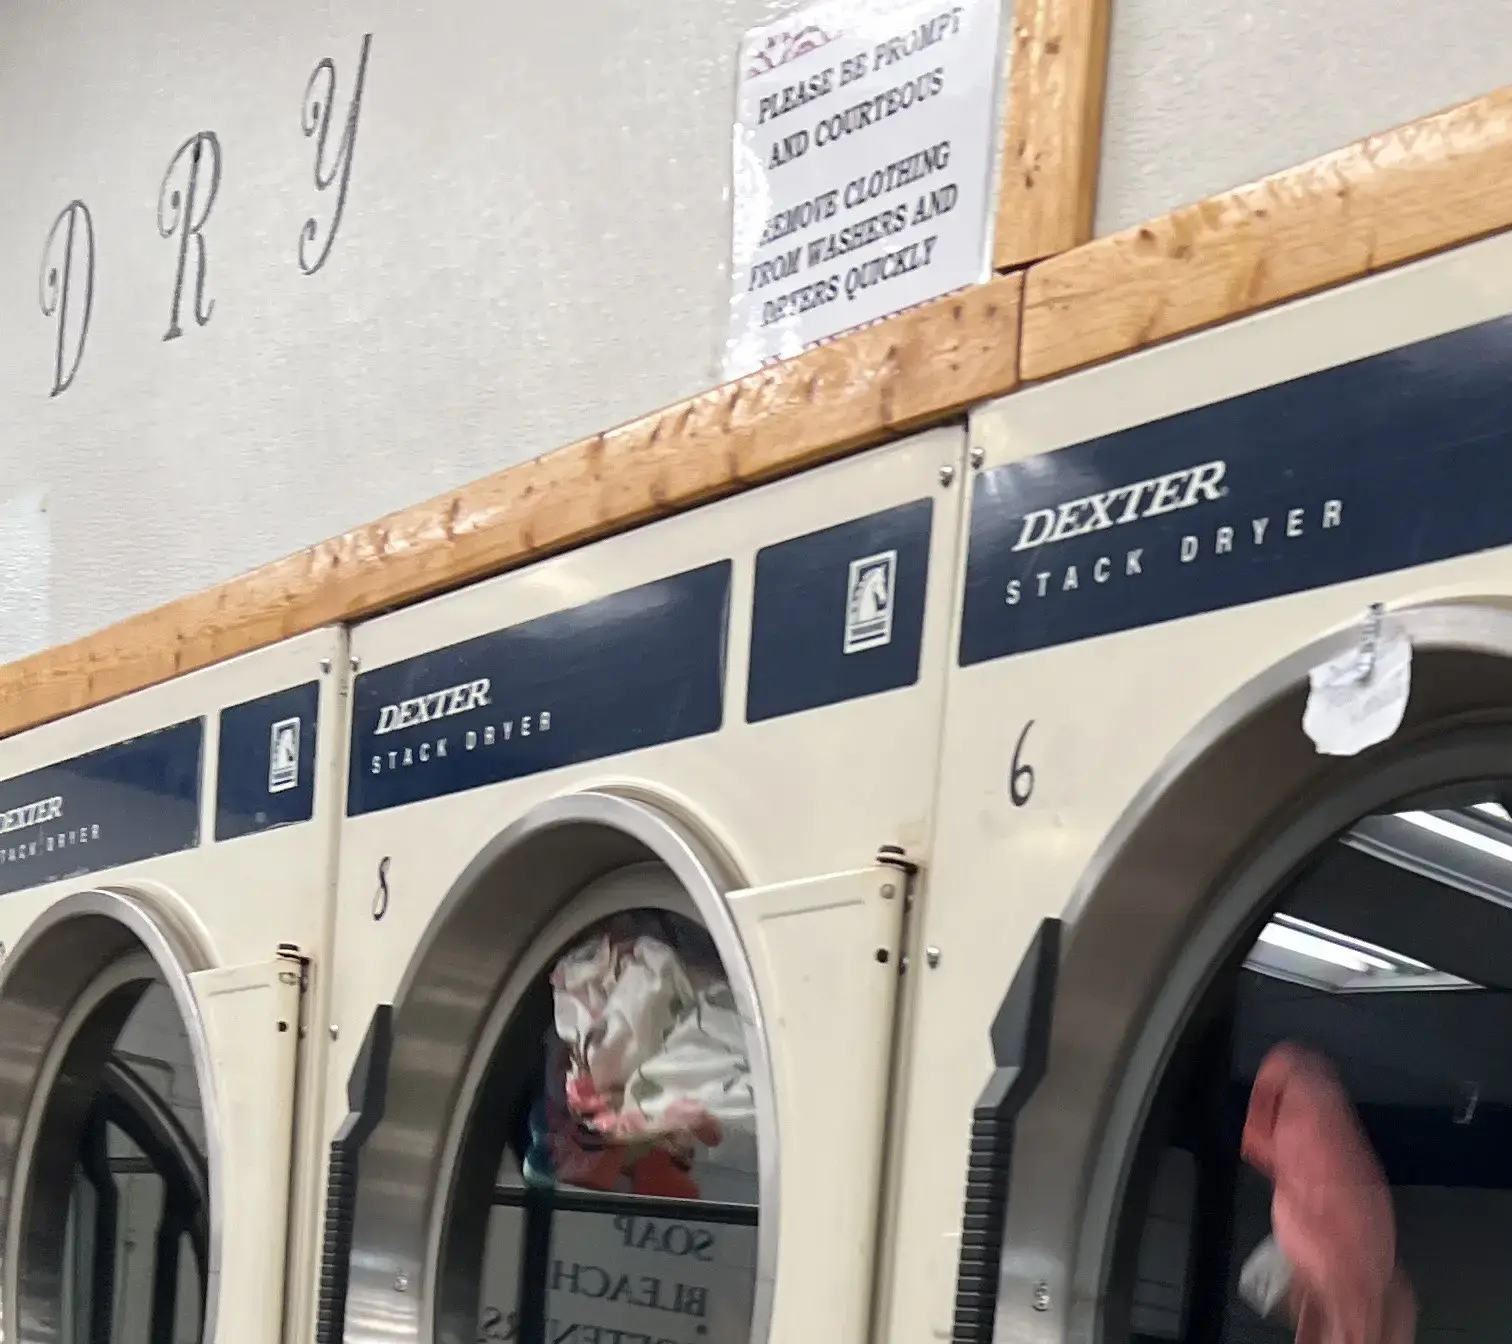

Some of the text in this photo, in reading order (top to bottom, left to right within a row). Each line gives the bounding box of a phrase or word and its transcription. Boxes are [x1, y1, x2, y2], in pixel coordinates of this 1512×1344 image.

[758, 8, 965, 125] PLEASE BE PROMPT
[768, 67, 945, 170] AND COURTEOUS
[843, 141, 952, 209] CLOTHING
[748, 184, 959, 292] FROM WASHERS AND
[844, 236, 939, 301] QUICKLY
[1011, 460, 1228, 552] DEXTER
[1005, 499, 1344, 606] STACK DRYER
[371, 710, 552, 775] STACK DRYER
[373, 677, 492, 736] DEXTER
[1010, 719, 1036, 808] 6
